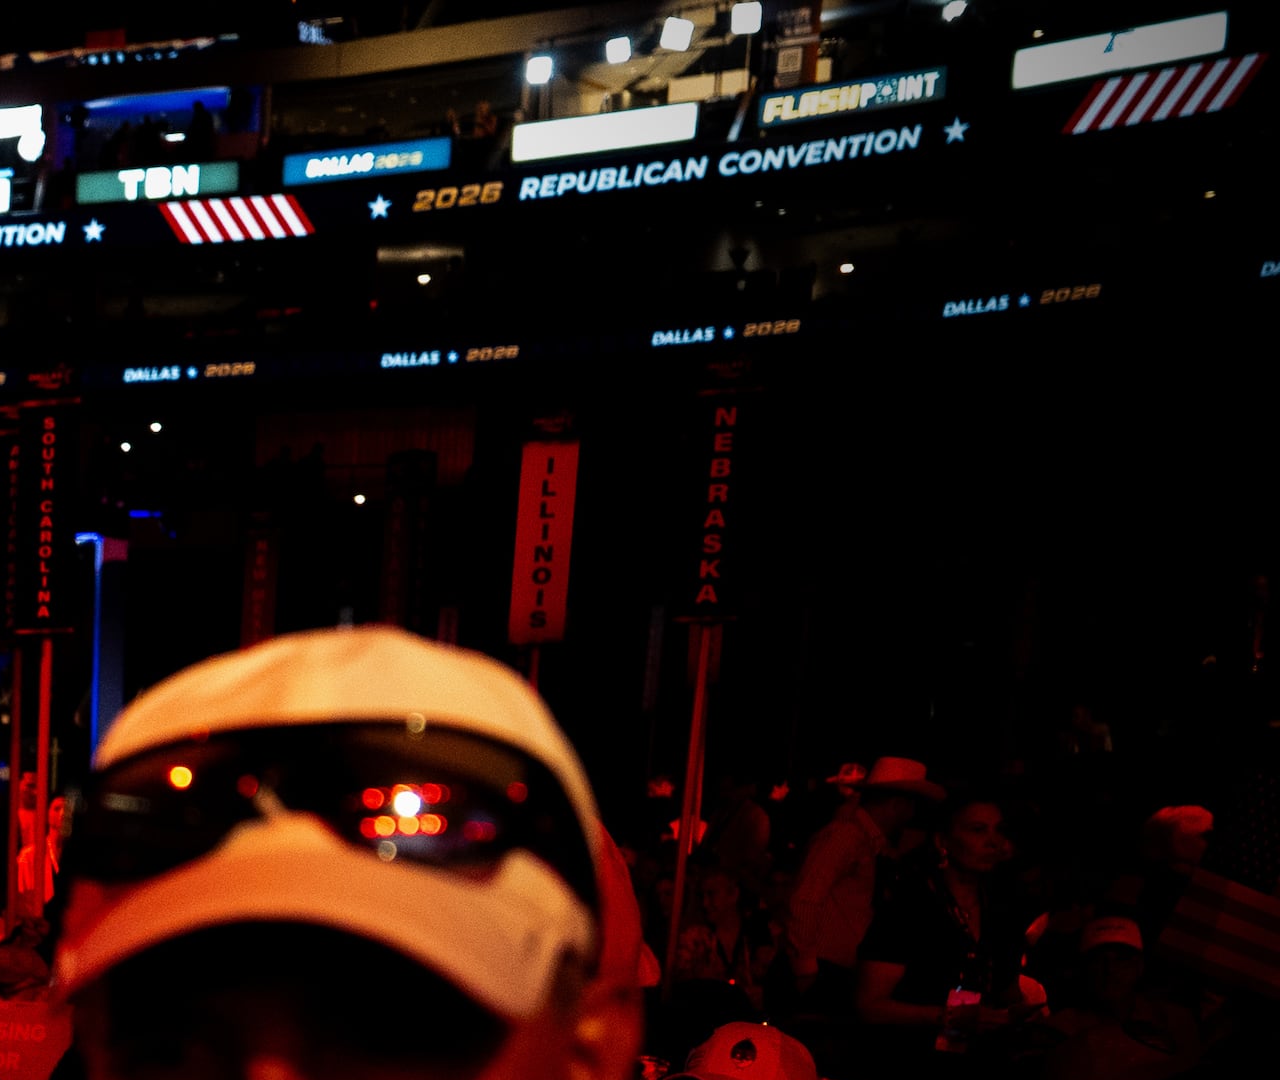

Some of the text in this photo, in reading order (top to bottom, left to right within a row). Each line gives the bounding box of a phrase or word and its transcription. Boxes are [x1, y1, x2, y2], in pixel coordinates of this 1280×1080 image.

[306, 152, 374, 179] DALLAS
[413, 124, 922, 212] 2026 REPUBLICAN CONVENTION
[118, 164, 200, 201] TBN
[942, 294, 1010, 318] DALLAS
[652, 326, 715, 346] DALLAS
[123, 365, 181, 383] DALLAS
[380, 350, 441, 368] DALLAS
[36, 416, 57, 618] SOUTH CAROLINA
[694, 405, 738, 605] NEBRASKA
[529, 456, 556, 629] ILLINOIS
